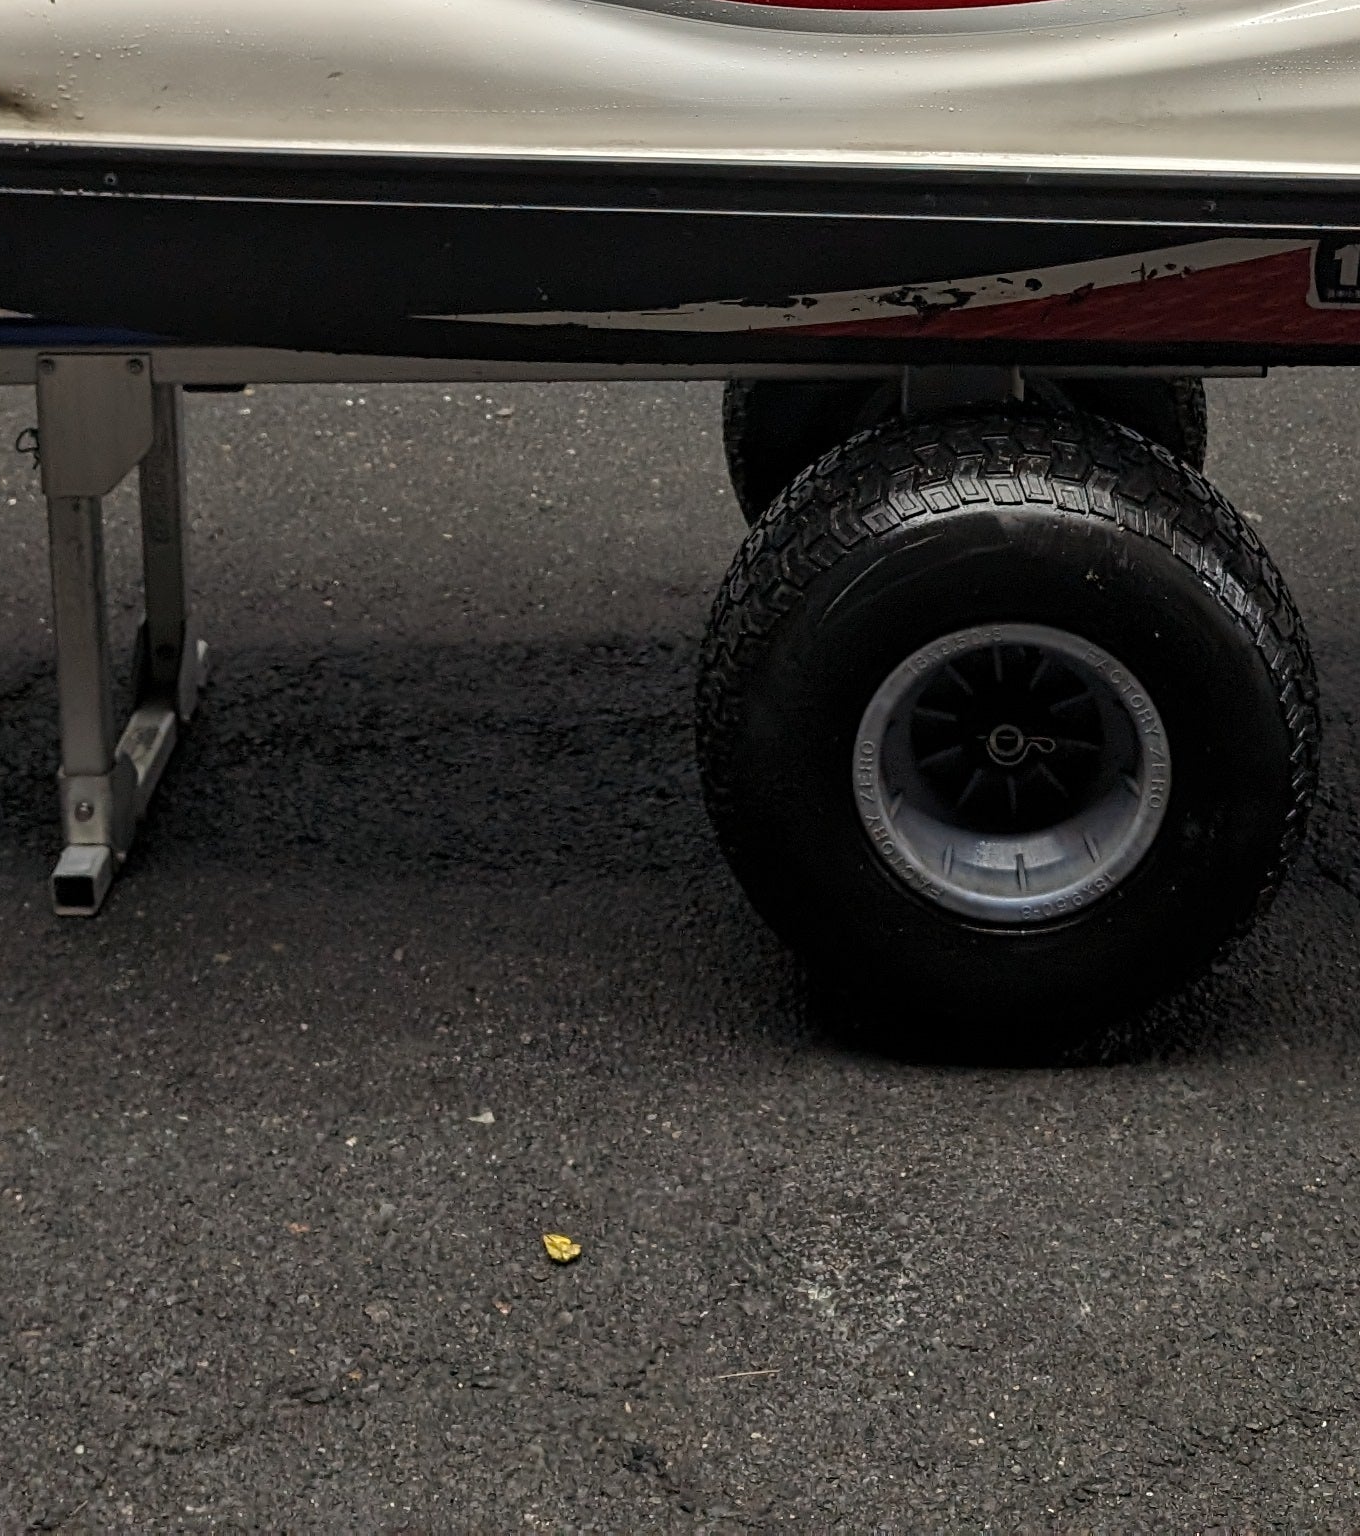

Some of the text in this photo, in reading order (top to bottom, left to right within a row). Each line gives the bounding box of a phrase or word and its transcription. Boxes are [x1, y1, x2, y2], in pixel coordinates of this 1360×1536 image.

[1082, 646, 1167, 809] FACTORY ZERO
[856, 739, 943, 901] FACTORY ZERO
